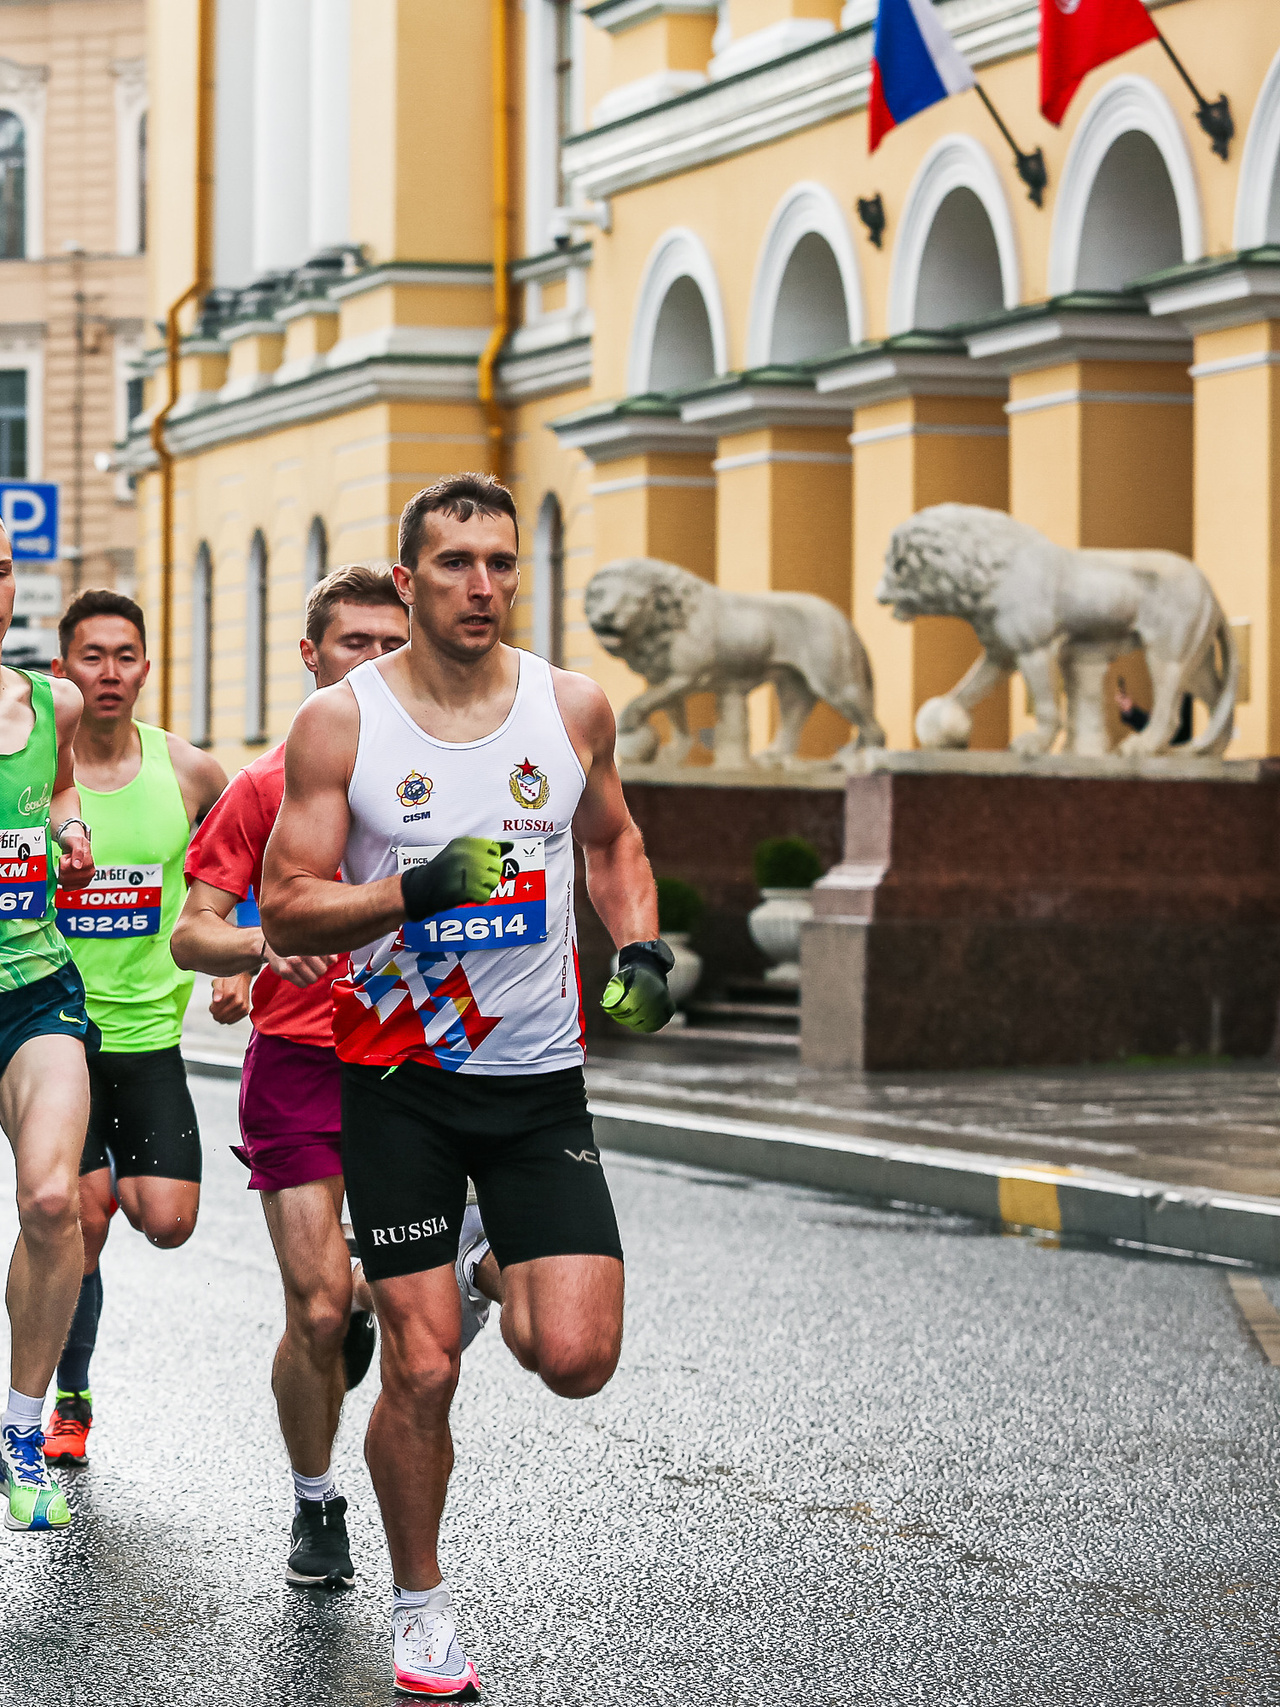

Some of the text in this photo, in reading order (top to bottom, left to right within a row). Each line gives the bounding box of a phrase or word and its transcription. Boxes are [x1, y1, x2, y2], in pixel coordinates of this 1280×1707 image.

[402, 811, 431, 823] CISM
[502, 819, 554, 832] RUSSIA
[67, 914, 149, 932] 13245
[424, 913, 528, 942] 12614
[371, 1215, 449, 1246] RUSSIA
